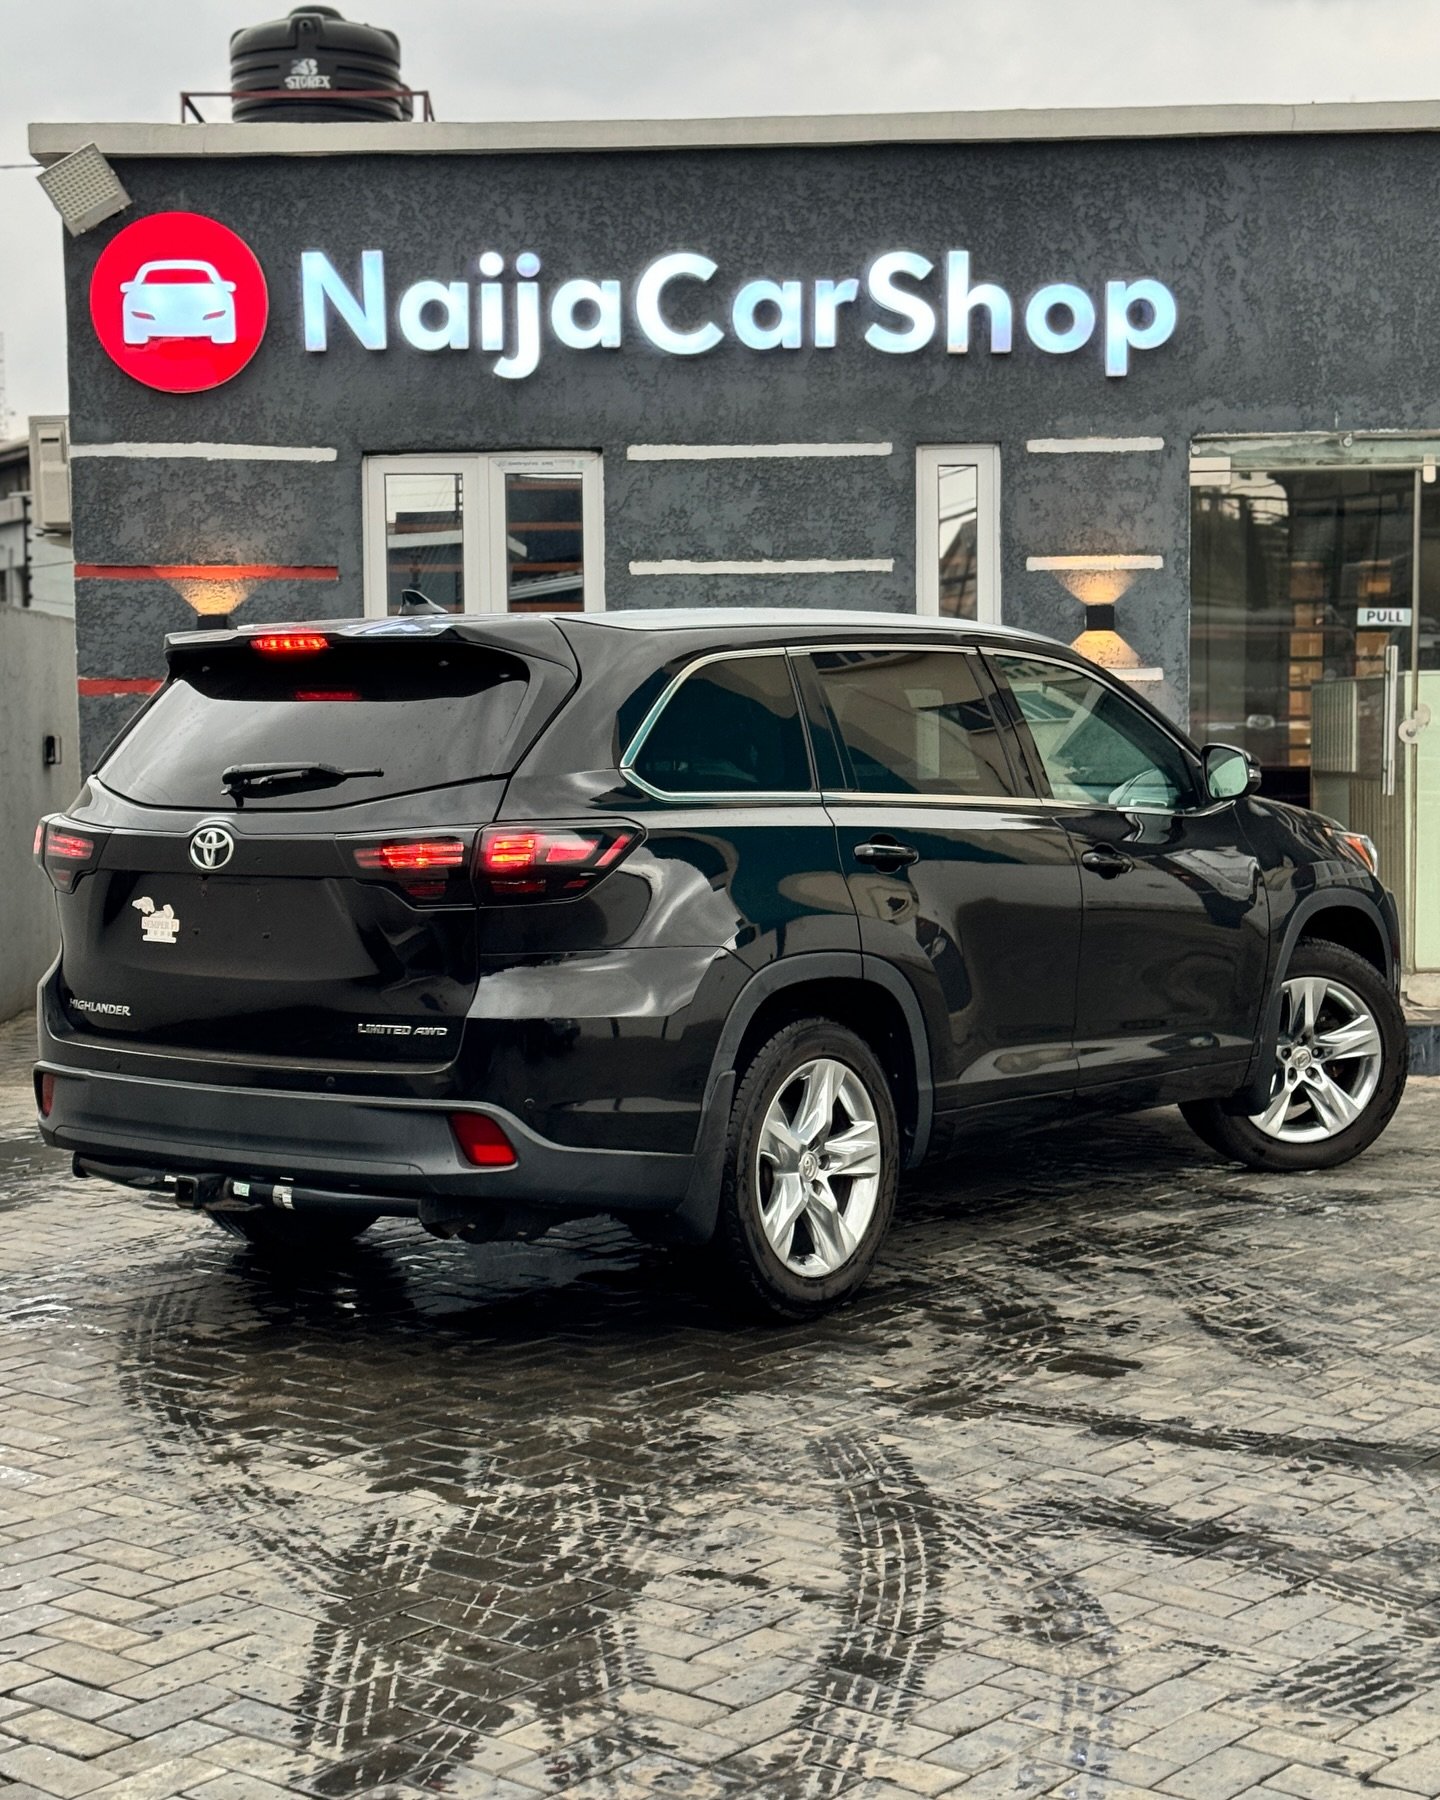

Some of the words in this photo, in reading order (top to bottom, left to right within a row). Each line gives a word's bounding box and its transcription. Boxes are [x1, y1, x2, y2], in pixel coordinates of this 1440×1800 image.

[284, 75, 331, 89] STOREX
[300, 249, 1178, 379] NaijaCarShop
[1366, 610, 1403, 622] PULL
[69, 998, 131, 1016] HIGHLANDER
[358, 1023, 412, 1035] LIMITED
[413, 1027, 448, 1035] AWD
